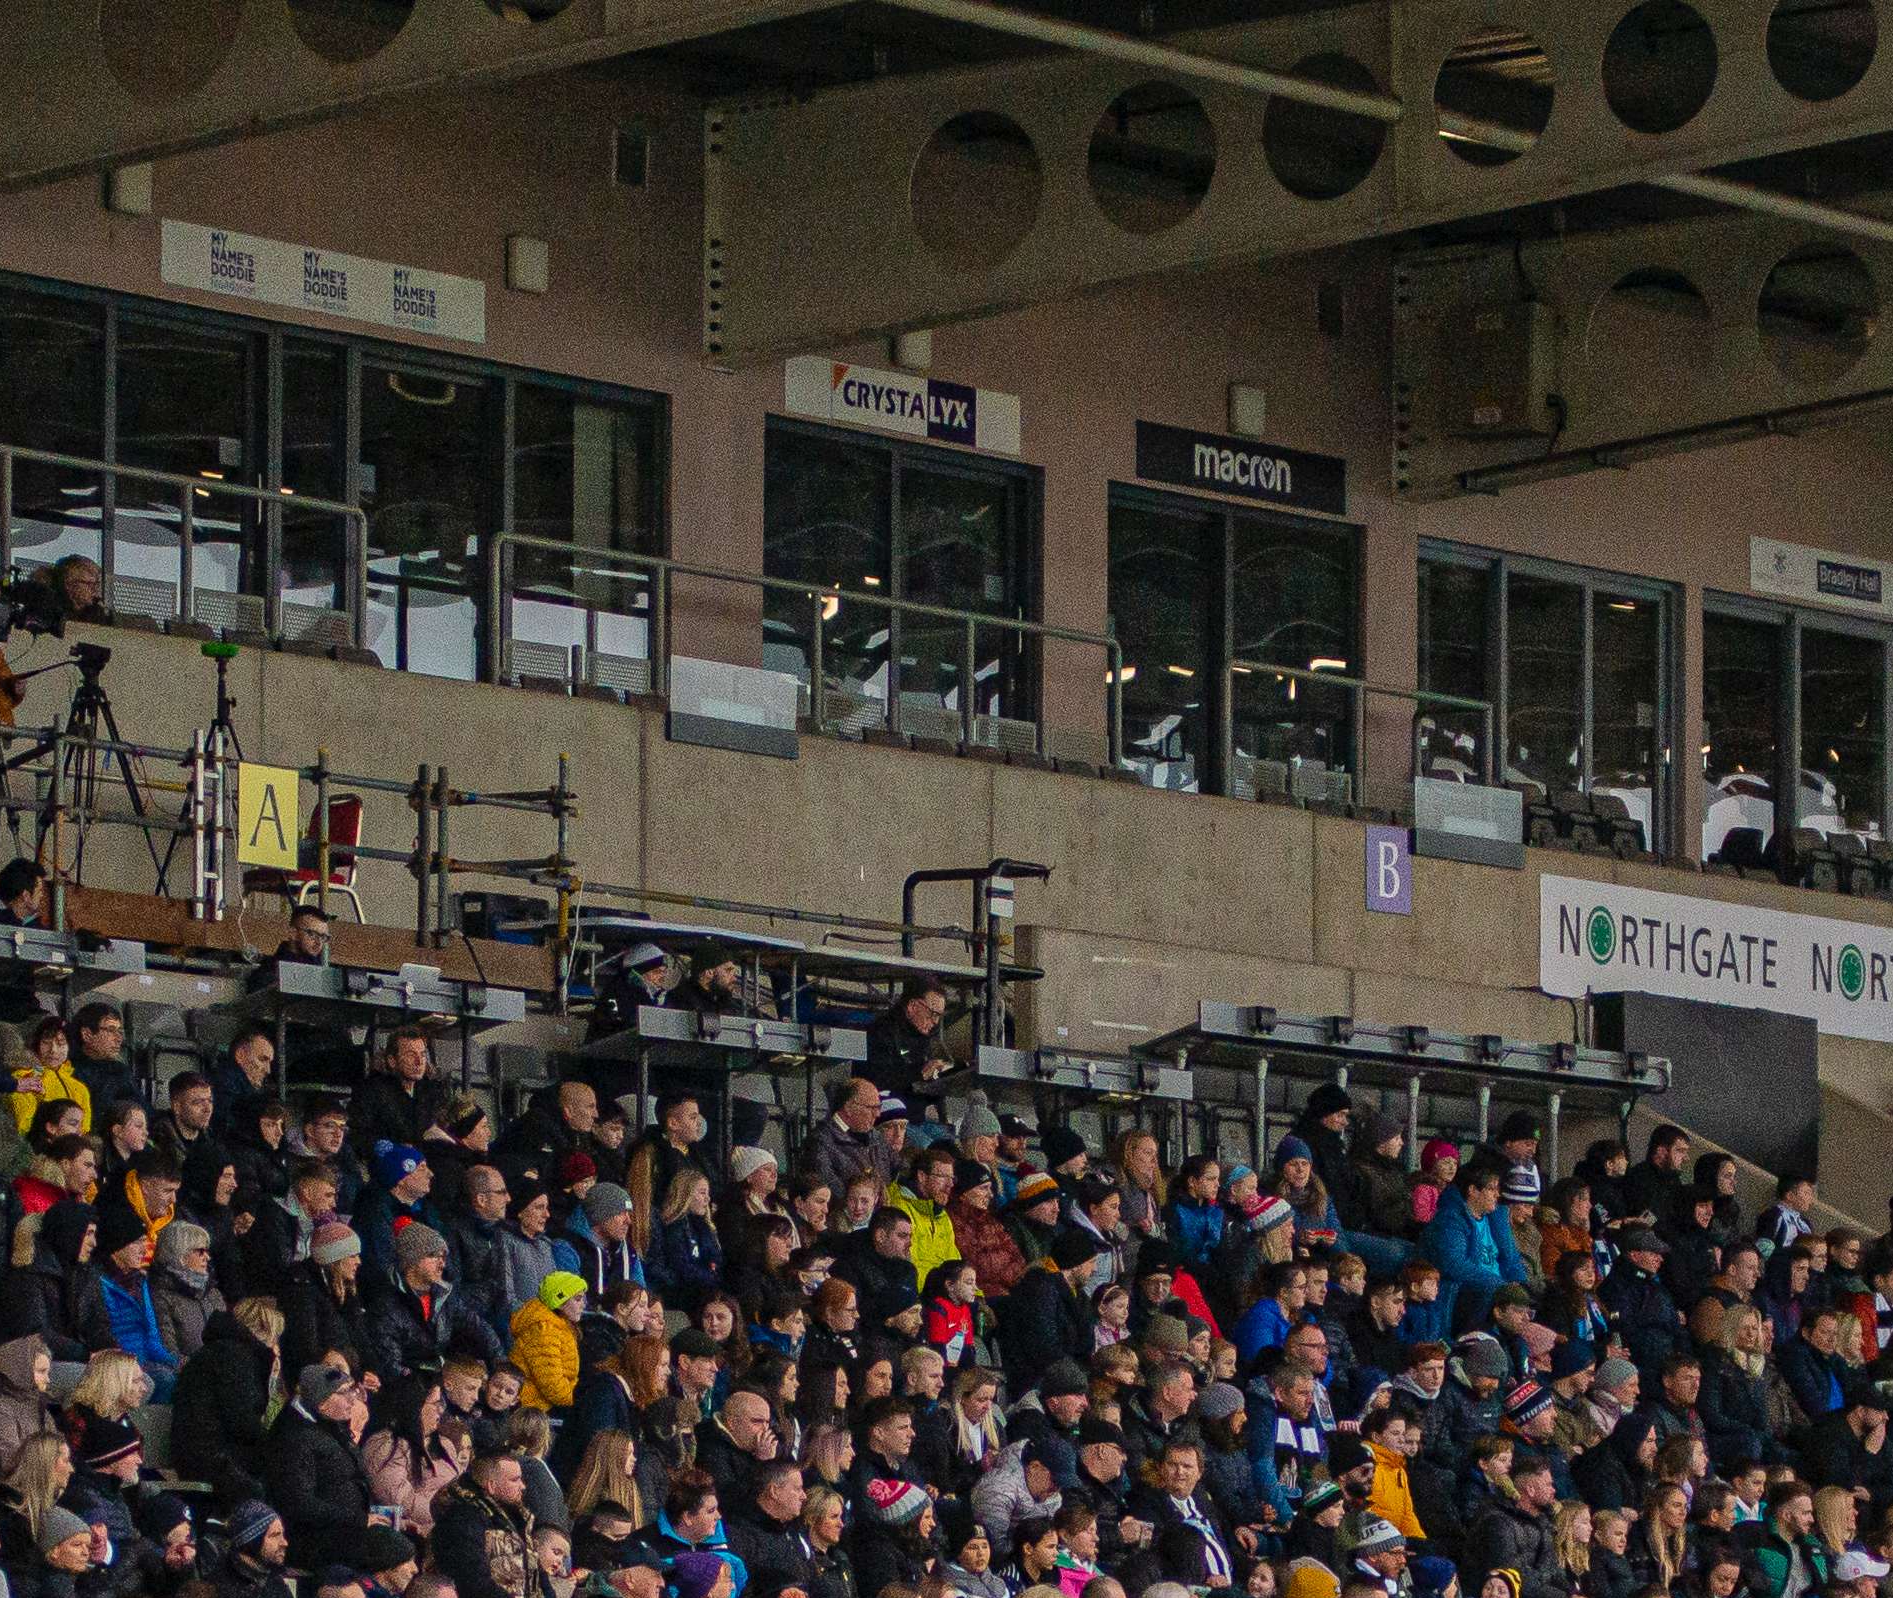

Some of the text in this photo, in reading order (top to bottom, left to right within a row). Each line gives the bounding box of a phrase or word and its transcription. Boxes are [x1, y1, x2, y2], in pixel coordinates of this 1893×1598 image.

[211, 231, 228, 245] MY
[211, 246, 254, 267] NAME'S
[304, 250, 320, 265] MY
[211, 261, 255, 283] DODDIE
[304, 265, 347, 286] NAME'S
[393, 268, 410, 283] MY
[304, 279, 348, 301] DODDIE
[393, 284, 436, 303] NAME'S
[393, 299, 437, 319] DODDIE
[843, 380, 968, 428] CRYSTALYX
[1194, 443, 1292, 493] macron
[1820, 564, 1857, 592] Bradley
[1859, 570, 1879, 592] Hall
[249, 783, 287, 852] A
[1378, 840, 1399, 899] B
[1559, 904, 1778, 989] NORTHGATE
